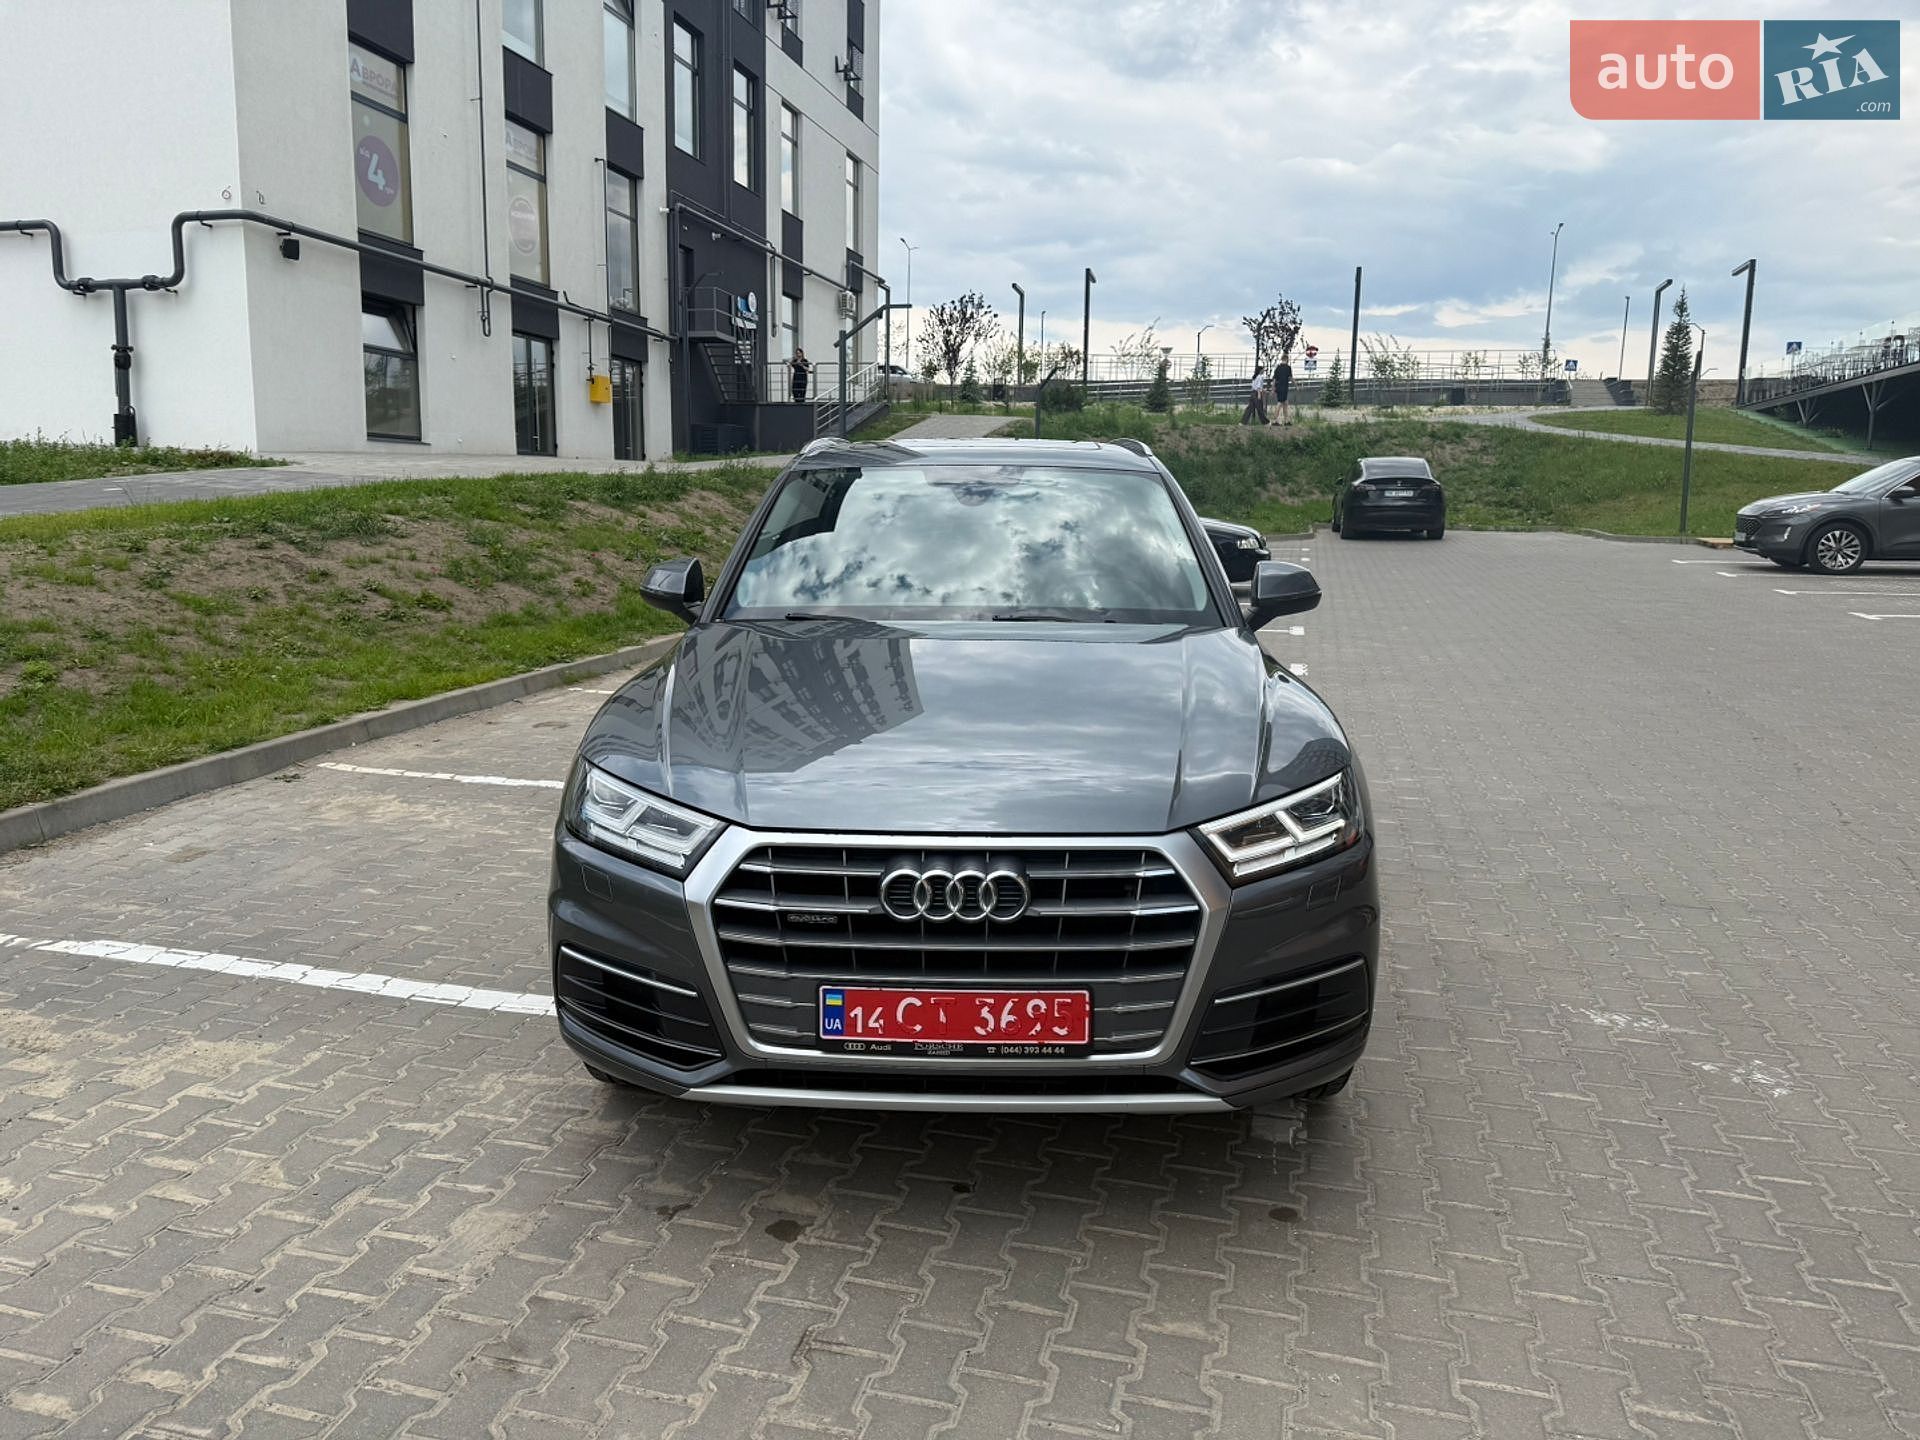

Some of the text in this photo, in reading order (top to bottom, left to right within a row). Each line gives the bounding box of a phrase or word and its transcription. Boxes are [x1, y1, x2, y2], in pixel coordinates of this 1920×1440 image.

[367, 153, 386, 190] 4
[825, 1018, 842, 1030] UA
[849, 1006, 884, 1034] 14
[869, 1043, 892, 1051] Audi
[1001, 1045, 1065, 1055] (044) 393 44 44
